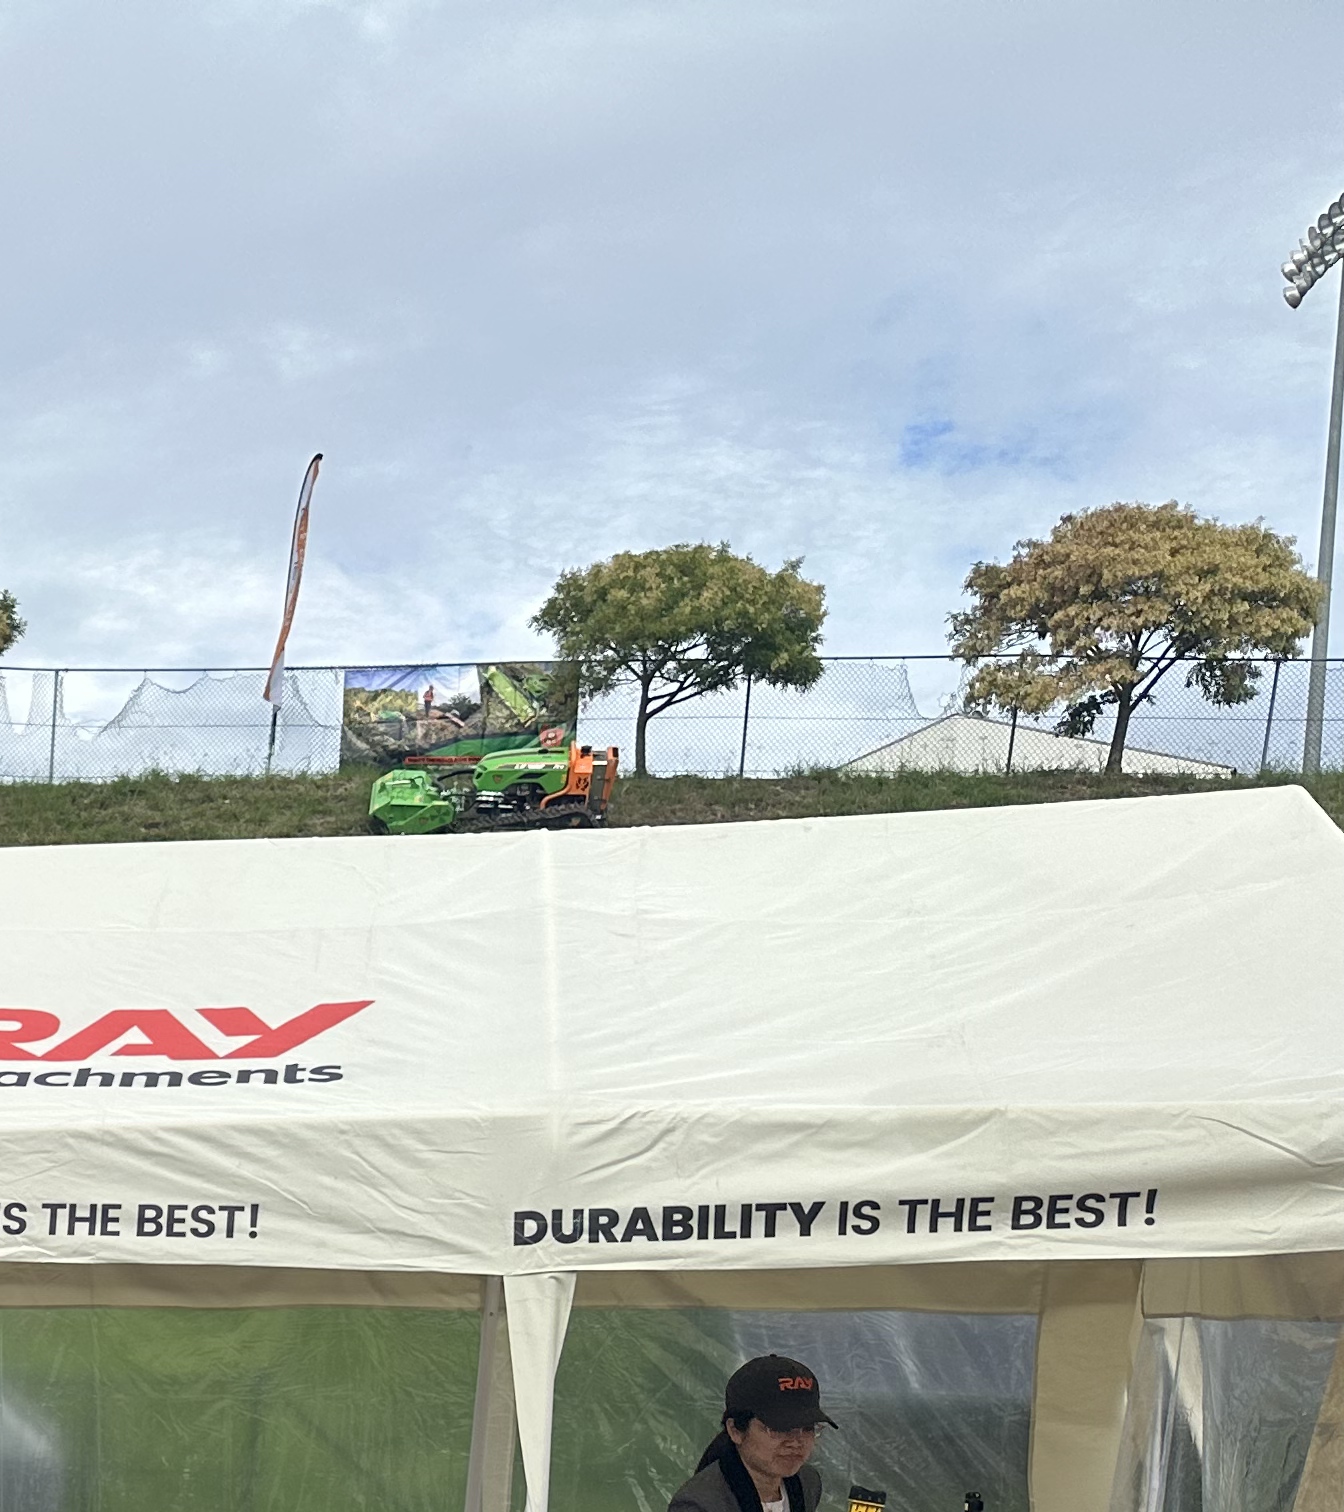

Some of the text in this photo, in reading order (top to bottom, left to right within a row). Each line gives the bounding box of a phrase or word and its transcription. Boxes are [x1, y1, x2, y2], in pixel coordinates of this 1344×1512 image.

[42, 1203, 121, 1237] THE
[136, 1203, 260, 1240] BEST!
[512, 1188, 1159, 1246] DURABILITY IS THE BEST!
[777, 1377, 813, 1391] RAY
